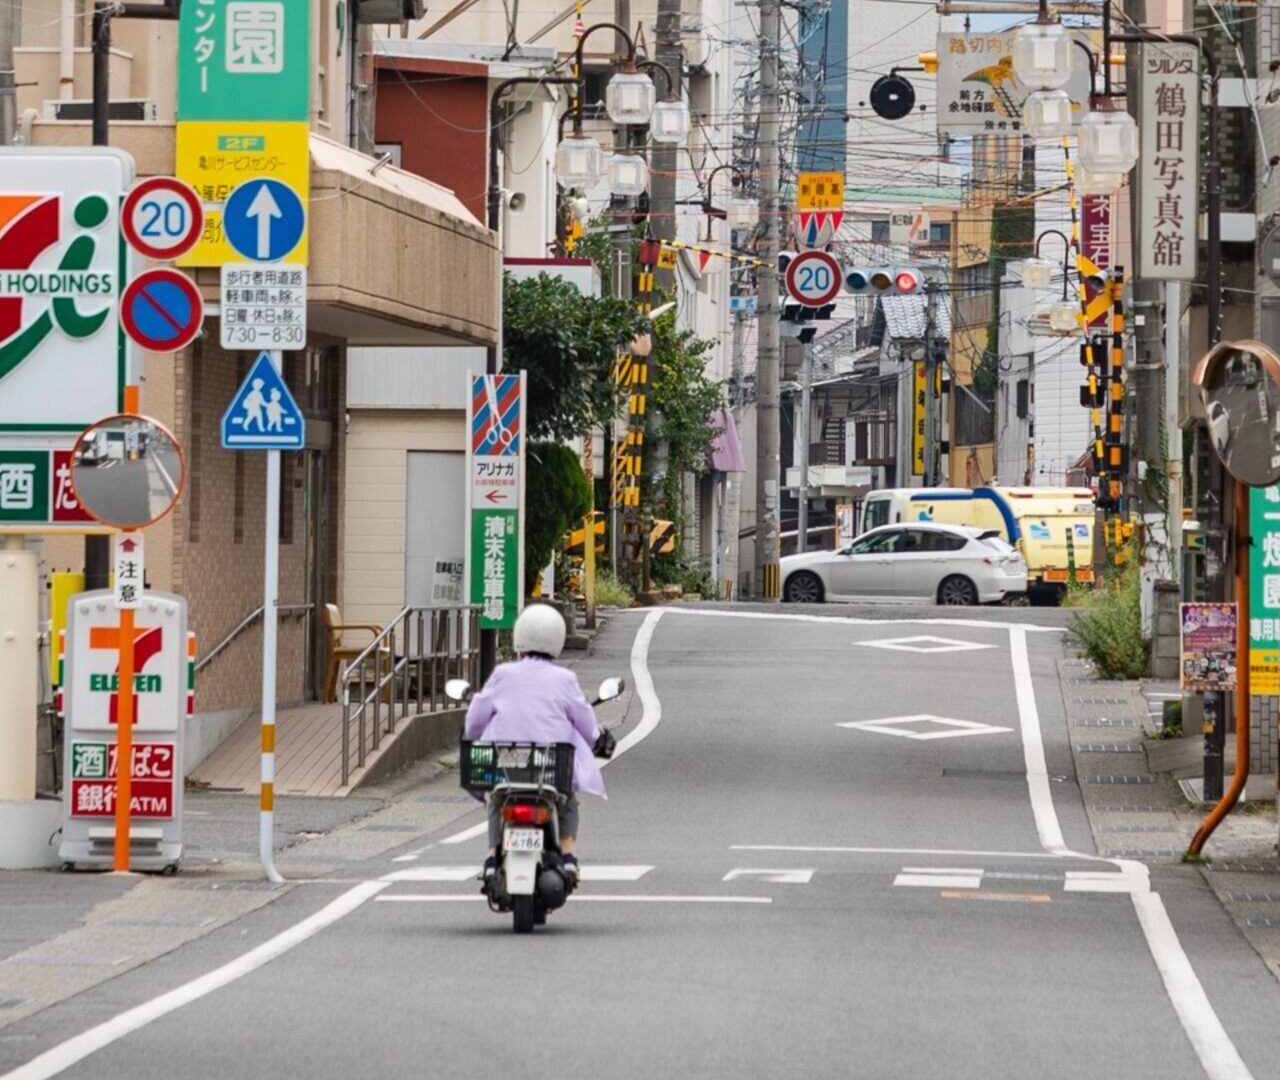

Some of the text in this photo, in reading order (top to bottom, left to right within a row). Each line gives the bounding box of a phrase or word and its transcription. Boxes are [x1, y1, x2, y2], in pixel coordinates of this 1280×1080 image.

[225, 138, 260, 150] 2F
[199, 156, 286, 171] 亀川サービスセンター
[1154, 82, 1187, 267] 鶴田写真館
[140, 201, 186, 237] 20
[7, 273, 112, 293] HOLDINGS
[227, 270, 303, 285] 歩行者用道路
[799, 266, 829, 292] 20
[226, 289, 302, 304] 軽車両を除く
[477, 462, 514, 476] アリナガ
[483, 515, 506, 620] 清末駐車場
[119, 560, 138, 603] 注意
[75, 745, 106, 777] 酒
[129, 796, 167, 812] ATM
